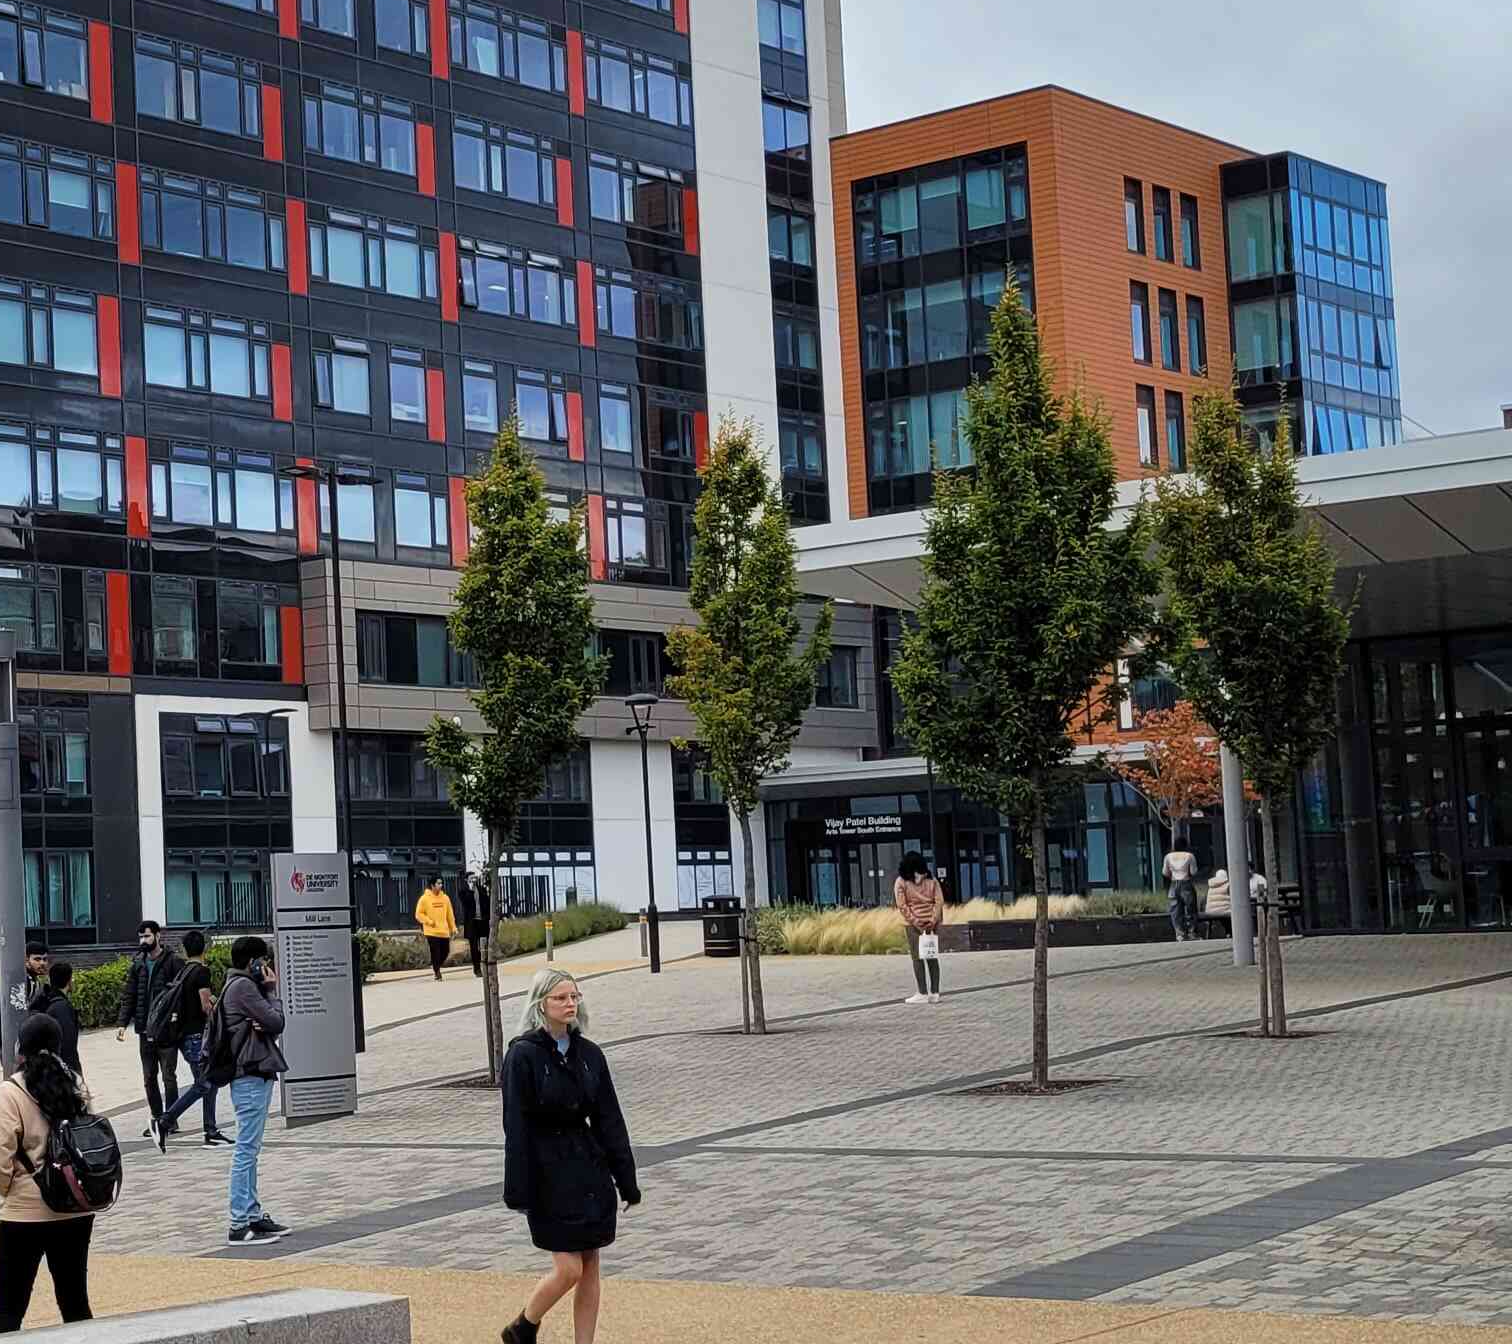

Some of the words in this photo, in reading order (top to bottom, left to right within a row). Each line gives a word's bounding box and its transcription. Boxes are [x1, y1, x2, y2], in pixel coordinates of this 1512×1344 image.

[824, 818, 844, 829] Vijay
[846, 817, 866, 826] Patel
[868, 816, 901, 826] Building
[306, 880, 339, 888] UNIVERSITY
